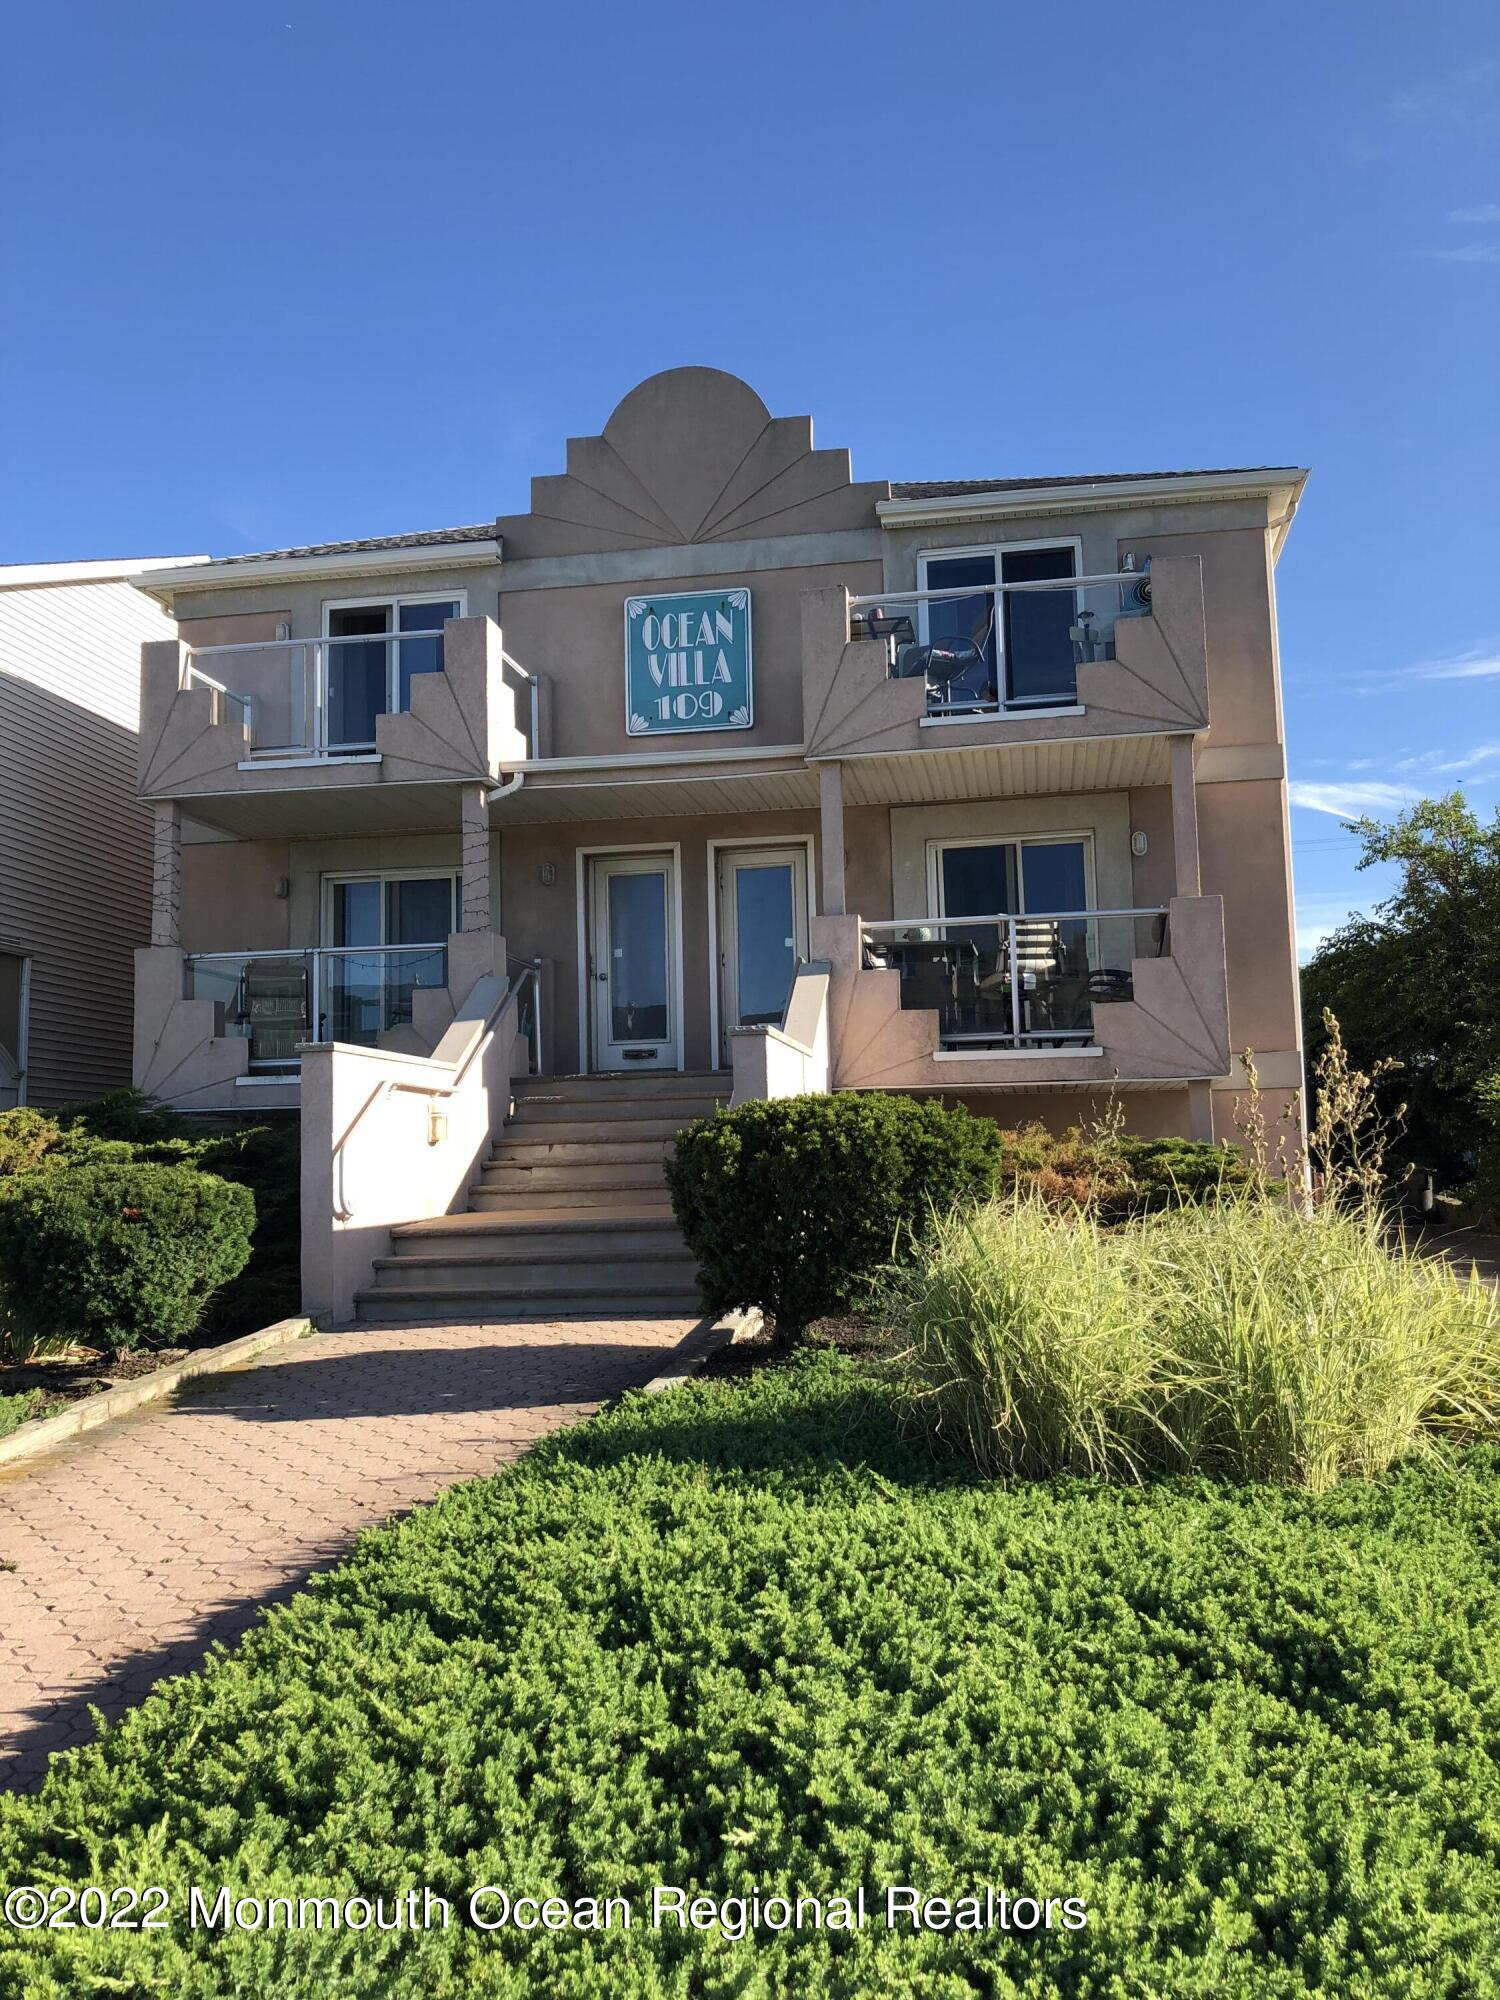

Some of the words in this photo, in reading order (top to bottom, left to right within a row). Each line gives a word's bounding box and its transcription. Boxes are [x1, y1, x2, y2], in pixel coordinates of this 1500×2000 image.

[642, 609, 733, 651] OCEAN
[647, 648, 732, 688] VILLA
[654, 690, 723, 720] 109
